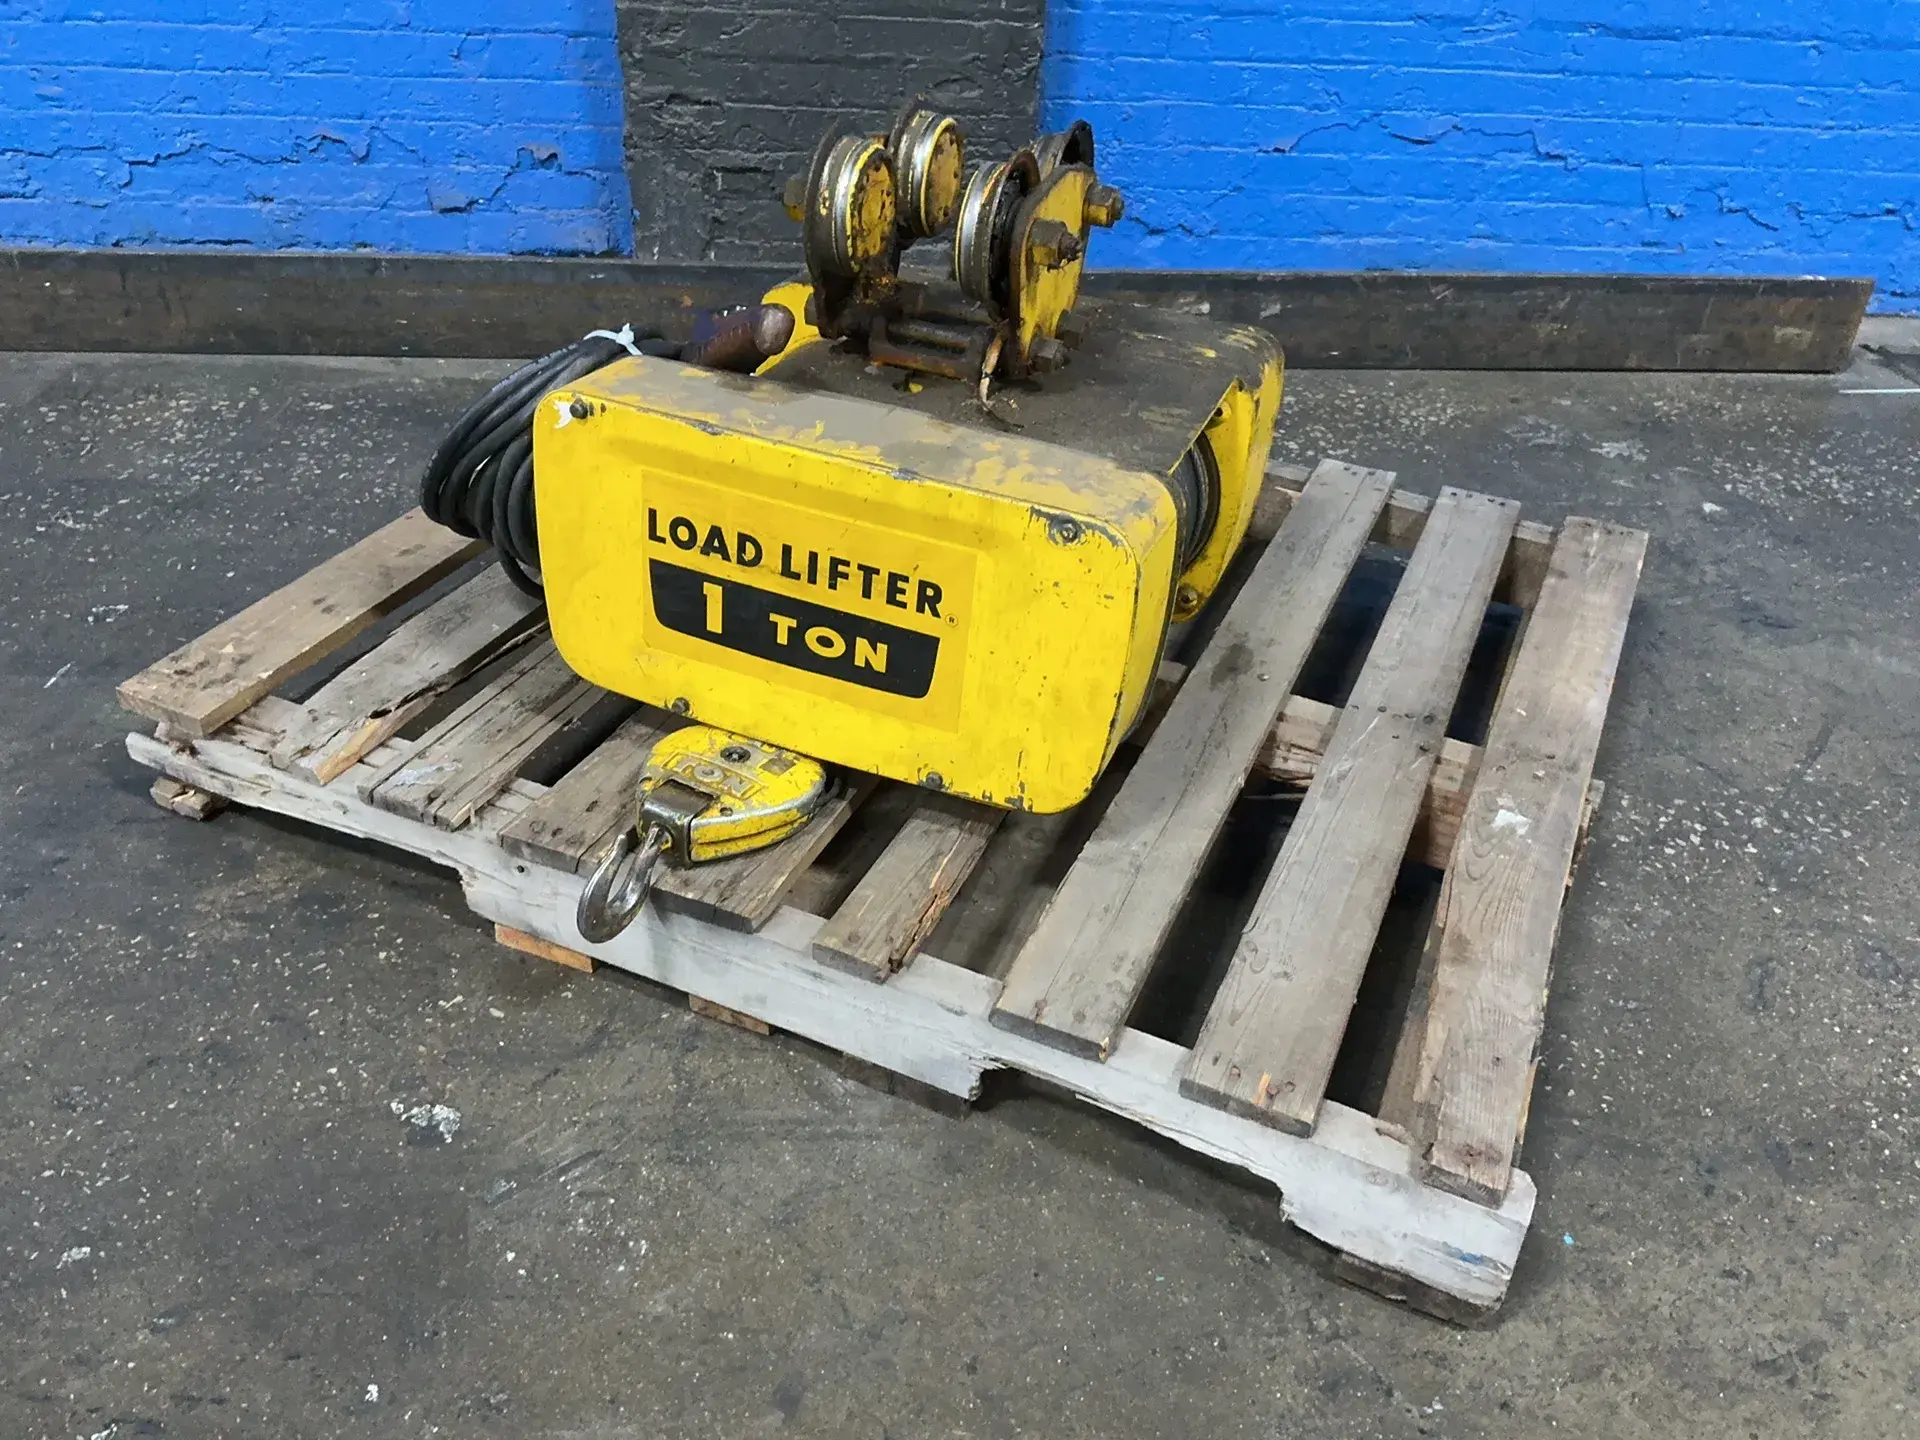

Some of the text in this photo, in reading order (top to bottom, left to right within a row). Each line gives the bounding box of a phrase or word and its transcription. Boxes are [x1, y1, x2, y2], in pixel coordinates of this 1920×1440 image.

[648, 507, 764, 568] LOAD
[780, 543, 943, 619] LIFTER
[702, 581, 888, 674] 1 TON
[675, 755, 753, 797] TON
